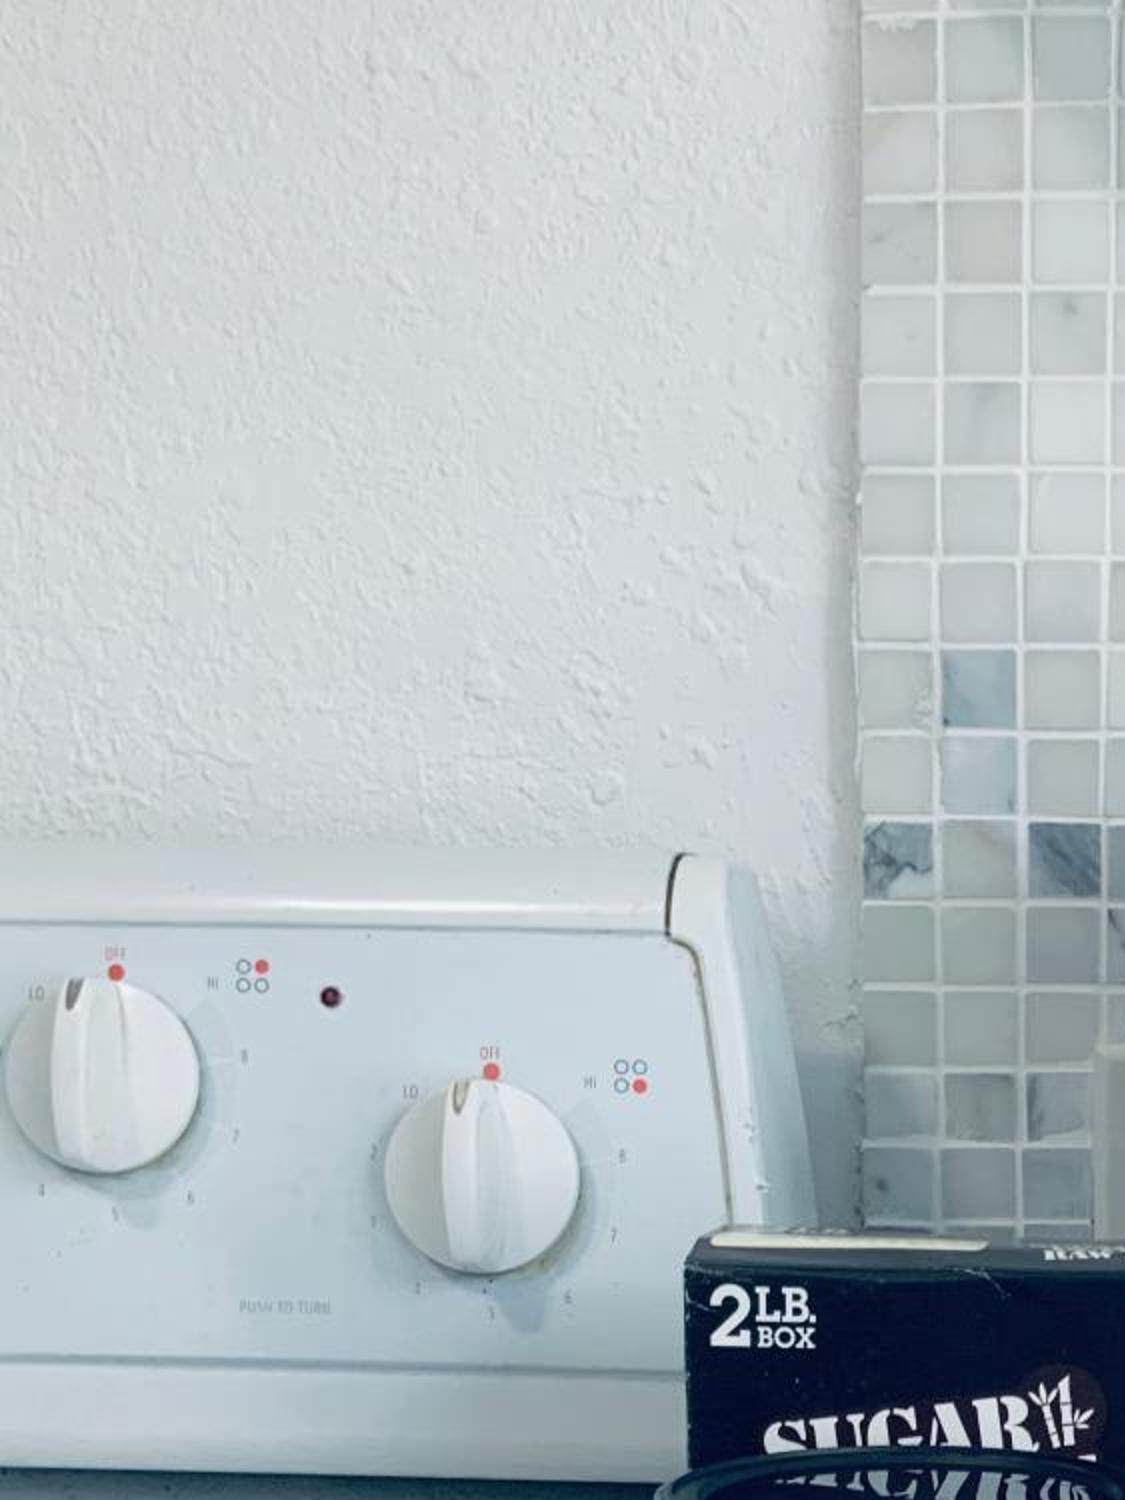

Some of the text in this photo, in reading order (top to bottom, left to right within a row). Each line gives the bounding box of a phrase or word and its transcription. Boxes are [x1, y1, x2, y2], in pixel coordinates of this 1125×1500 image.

[709, 1283, 816, 1348] 2 LB.
[757, 1326, 816, 1348] BOX
[763, 1395, 1040, 1455] SUGAR
